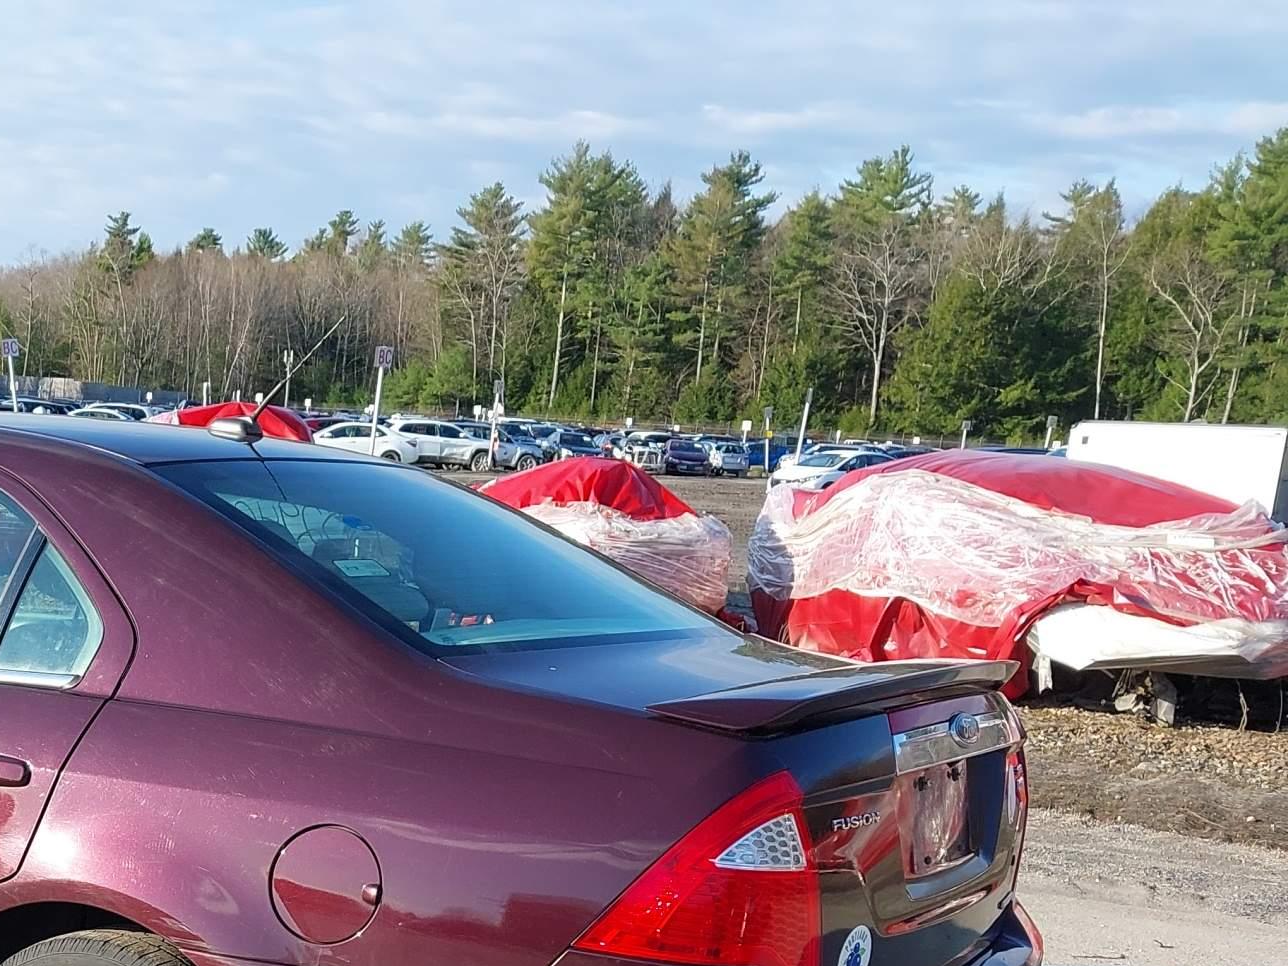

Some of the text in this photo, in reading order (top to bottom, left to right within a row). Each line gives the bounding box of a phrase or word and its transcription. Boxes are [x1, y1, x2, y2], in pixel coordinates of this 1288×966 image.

[3, 341, 18, 355] BC
[378, 349, 392, 365] BC
[832, 811, 880, 832] FUSION
